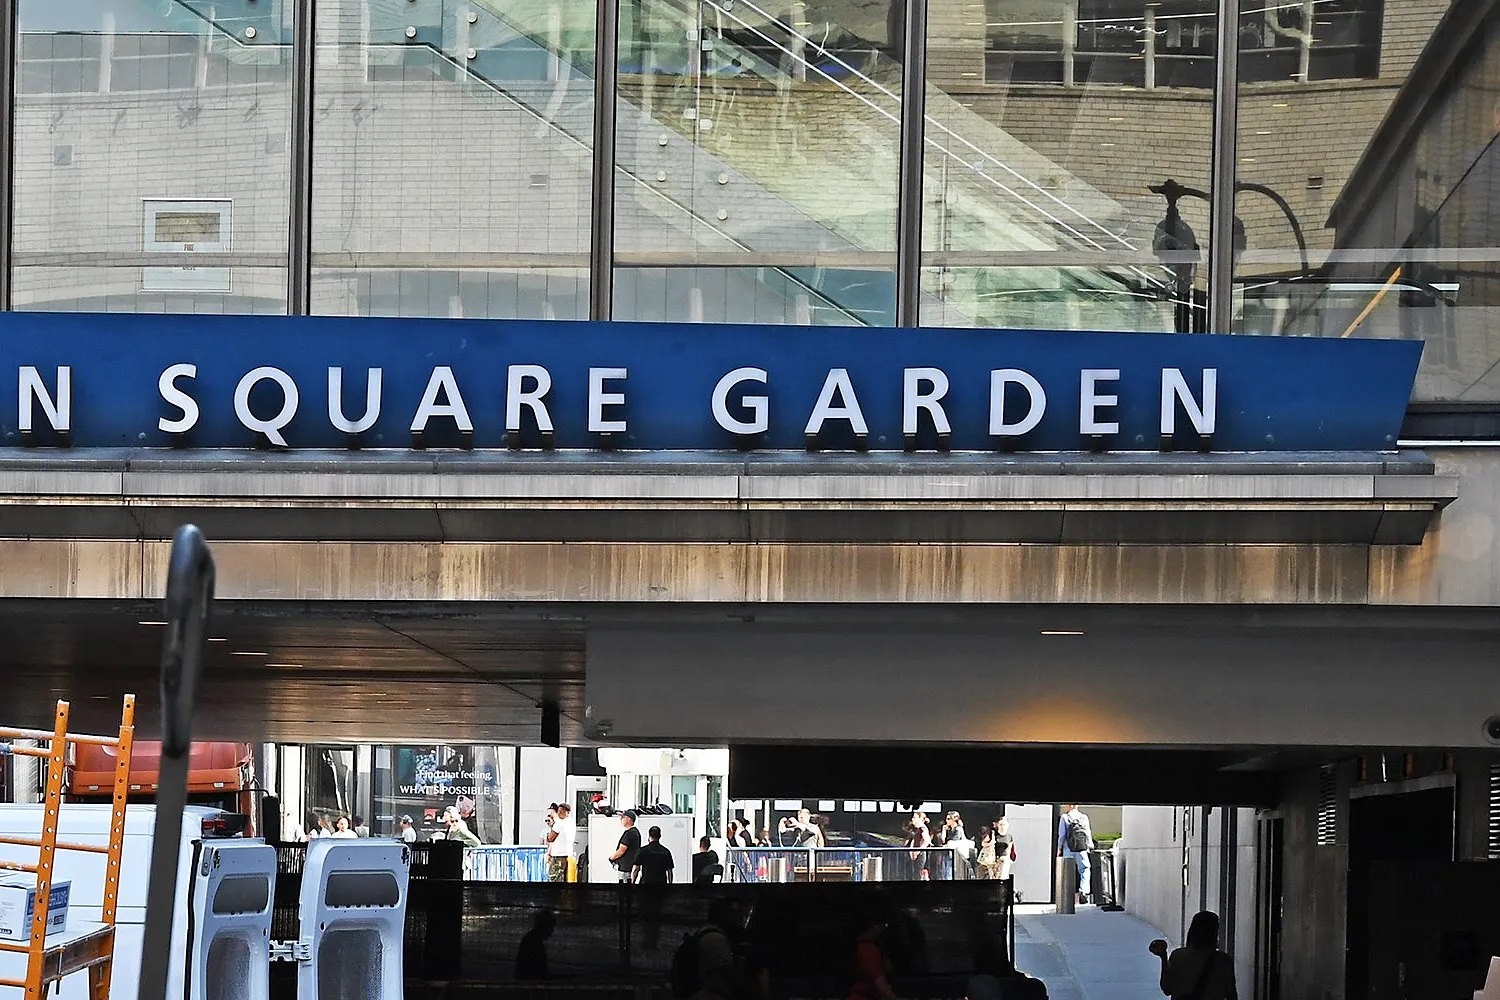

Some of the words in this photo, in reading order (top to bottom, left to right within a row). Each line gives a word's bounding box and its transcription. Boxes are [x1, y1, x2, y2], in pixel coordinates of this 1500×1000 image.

[158, 363, 628, 447] SQUARE
[711, 367, 1218, 436] GARDEN
[400, 785, 439, 795] WHAT'S
[443, 785, 490, 795] POSSIBLE
